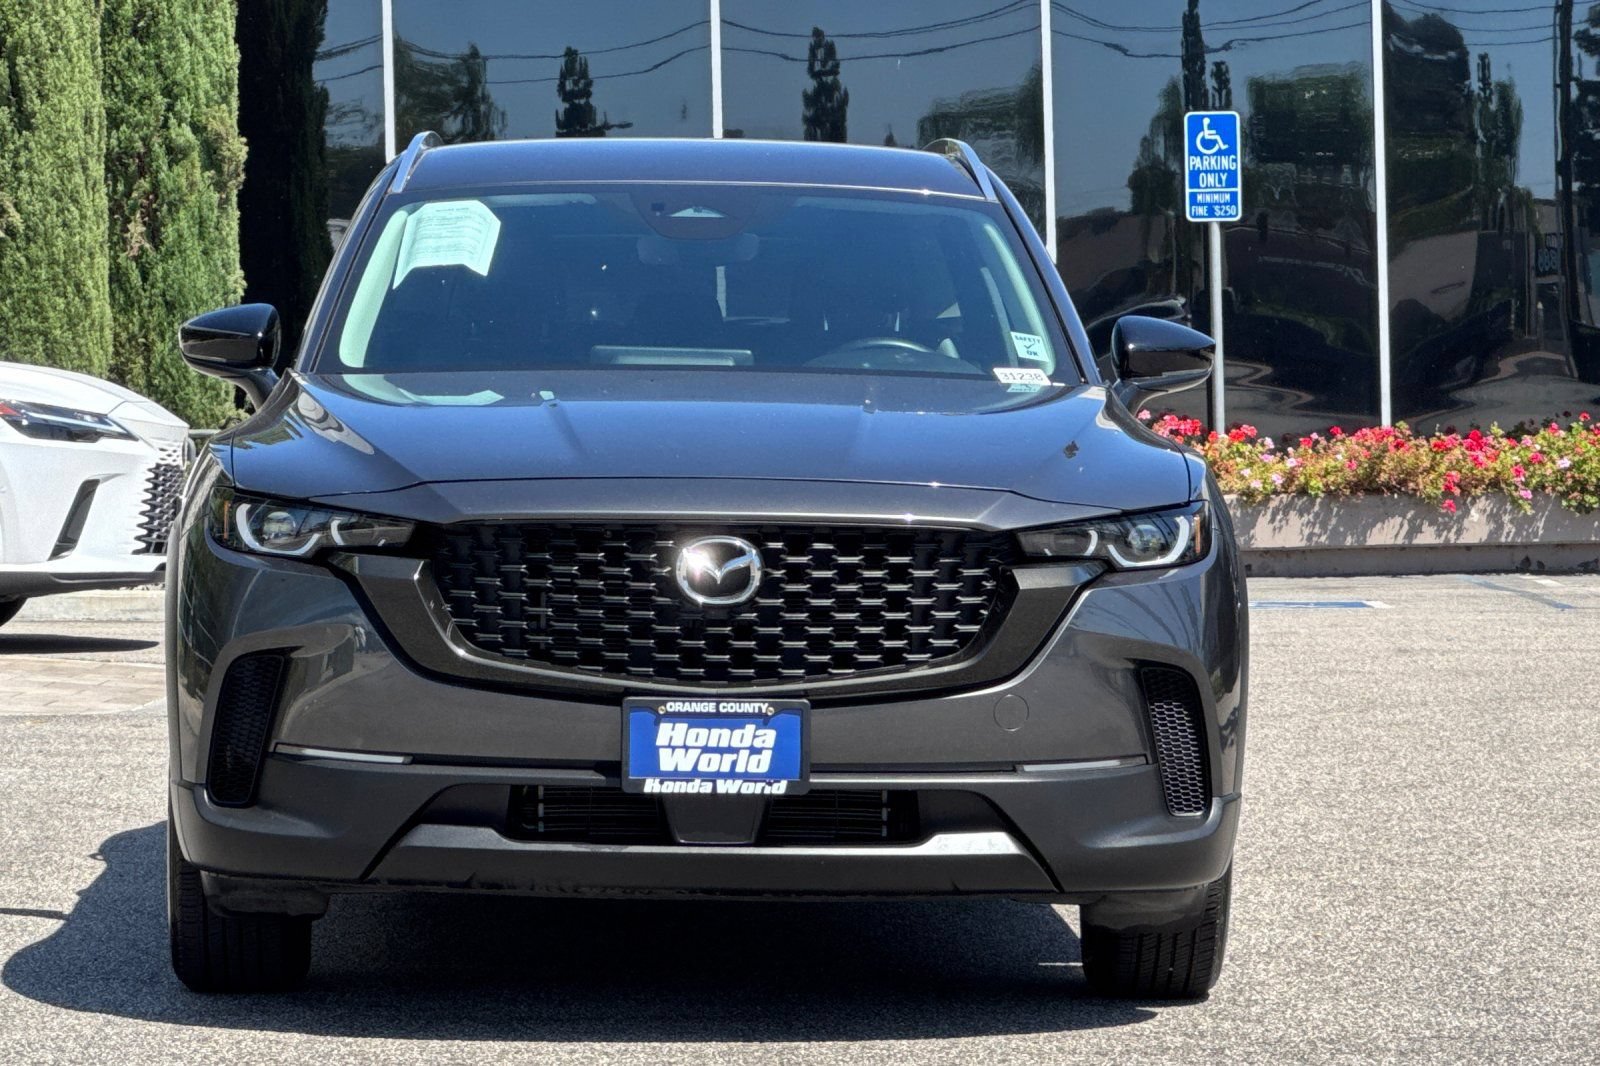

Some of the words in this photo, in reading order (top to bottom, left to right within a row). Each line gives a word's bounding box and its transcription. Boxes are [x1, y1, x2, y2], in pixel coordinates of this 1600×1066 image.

[1189, 155, 1237, 171] PARKING
[1199, 172, 1228, 188] ONLY
[1196, 193, 1231, 204] MINIMUM
[1191, 205, 1209, 216] FINE
[1213, 205, 1237, 217] $250
[1000, 372, 1044, 382] 31238
[666, 702, 717, 713] ORANGE
[719, 702, 769, 713] COUNTY
[655, 722, 777, 749] Honda
[659, 748, 773, 774] World
[643, 778, 713, 793] Honda
